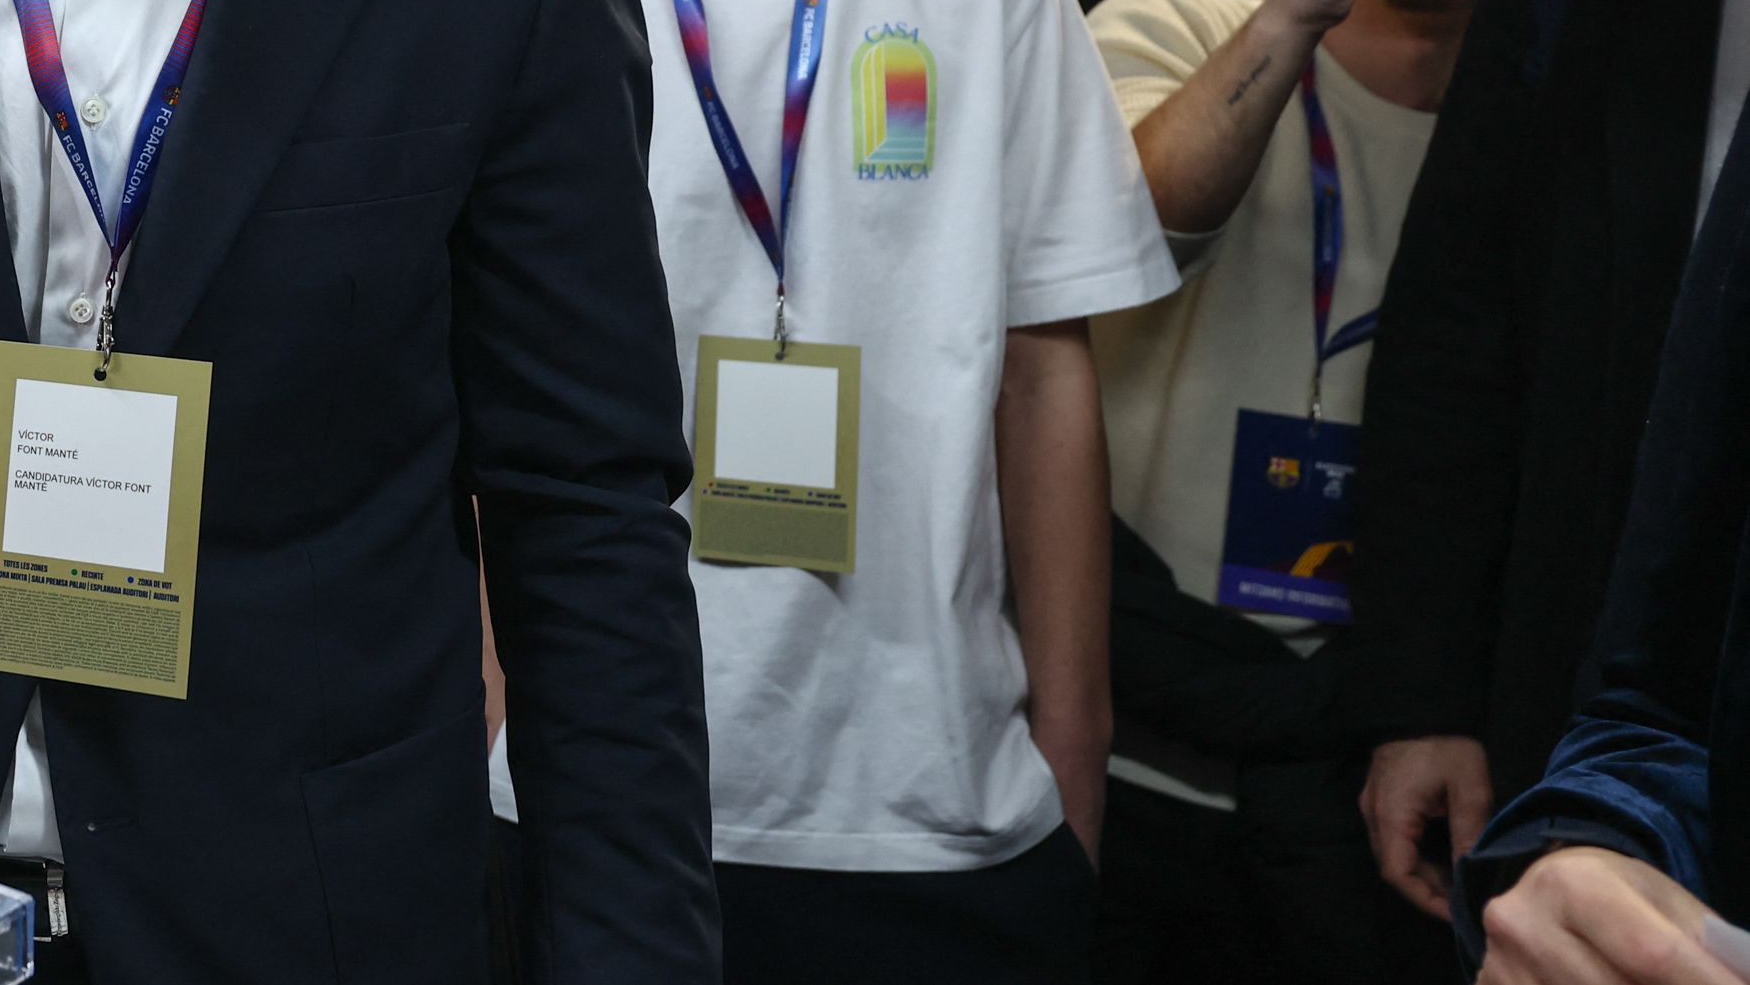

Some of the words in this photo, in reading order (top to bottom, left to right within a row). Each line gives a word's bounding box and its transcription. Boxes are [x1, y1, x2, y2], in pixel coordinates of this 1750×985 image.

[864, 22, 919, 44] CASA
[797, 21, 813, 80] BARCELONA
[156, 107, 172, 126] FC
[123, 125, 165, 204] BARCELONA
[858, 163, 929, 182] BLANCA
[62, 134, 76, 153] FC
[71, 152, 105, 222] BARCEL
[18, 429, 54, 442] VÍCTOR
[17, 445, 43, 455] FONT
[45, 448, 79, 460] MANTÉ
[14, 480, 47, 492] MANTÉ
[15, 470, 84, 486] CANDIDATURA
[86, 477, 122, 490] VÍCTOR
[124, 482, 152, 494] FONT
[3, 559, 20, 569] TOTES
[20, 561, 30, 570] LES
[31, 575, 45, 584] SALA
[153, 579, 161, 588] DE
